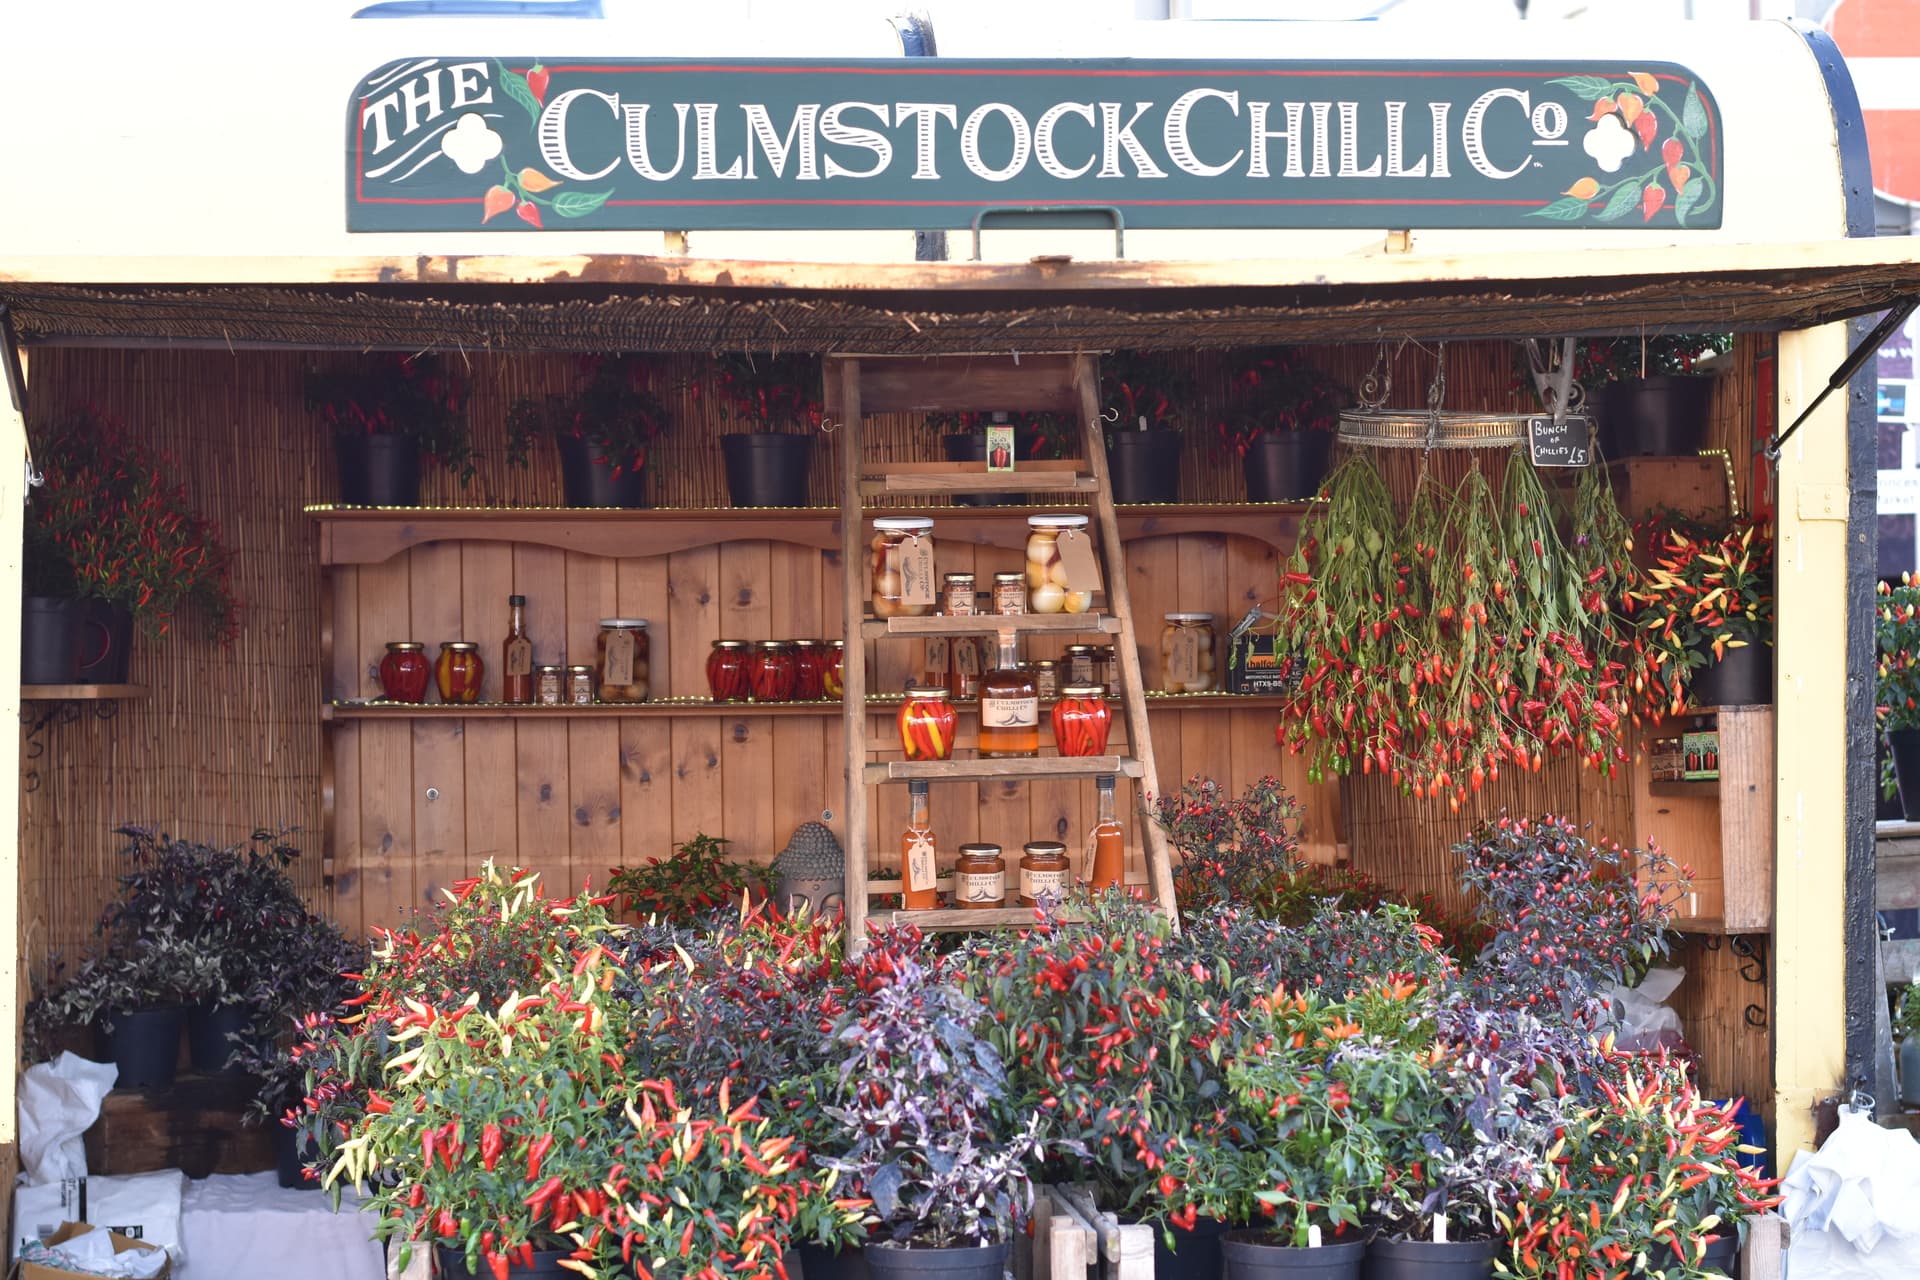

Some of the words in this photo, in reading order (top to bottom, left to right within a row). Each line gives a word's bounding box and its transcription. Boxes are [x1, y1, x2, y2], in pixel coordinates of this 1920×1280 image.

[361, 61, 493, 156] THE
[1535, 421, 1568, 436] BUNCH
[1535, 445, 1569, 458] CHILLIES
